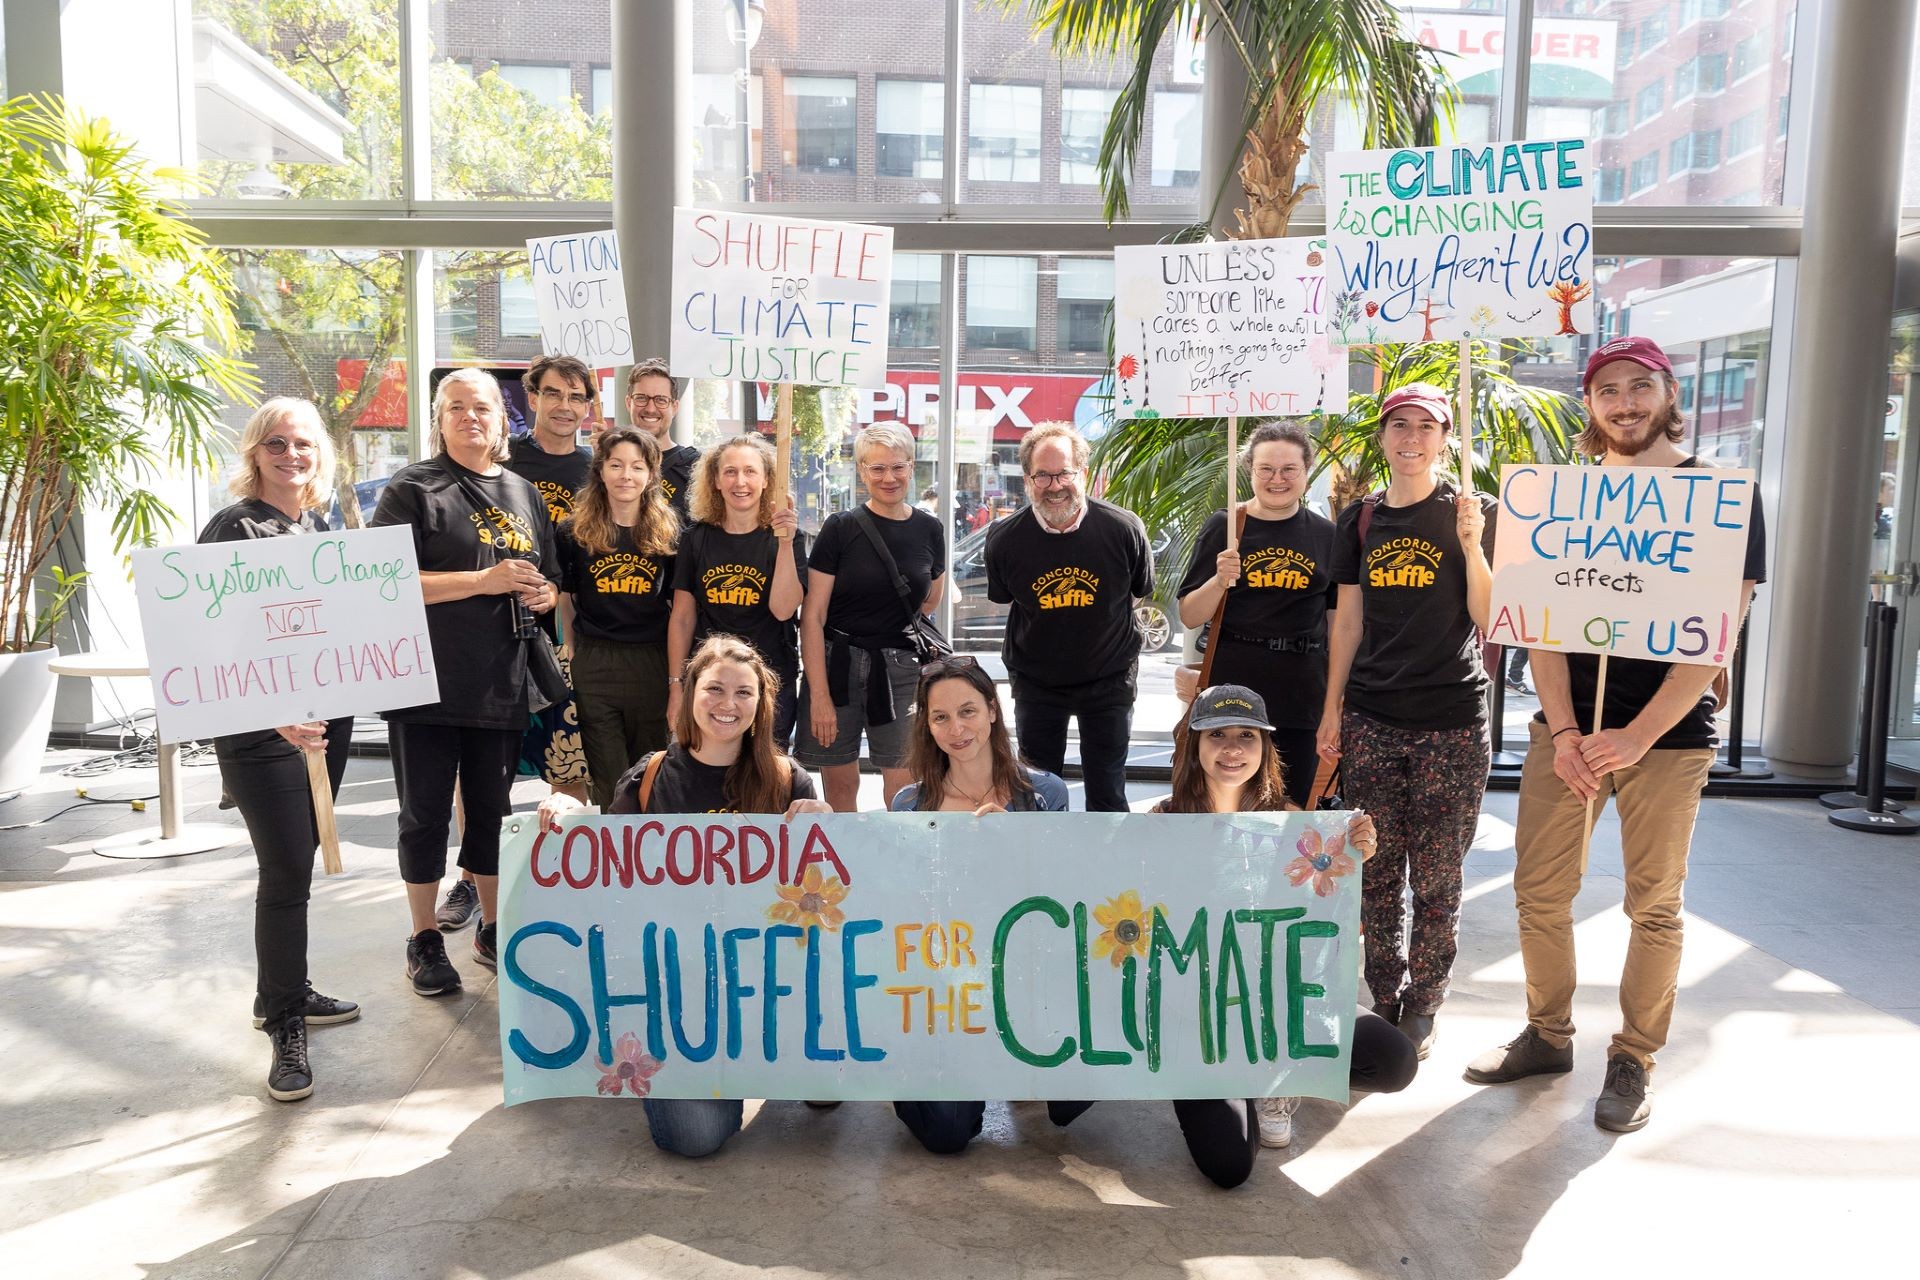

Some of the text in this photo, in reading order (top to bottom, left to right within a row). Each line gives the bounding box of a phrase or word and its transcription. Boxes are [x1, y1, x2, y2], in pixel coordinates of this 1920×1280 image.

[1340, 139, 1585, 201] THE CLIMATE
[1333, 200, 1545, 238] is CHANGING
[532, 234, 619, 276] ACTION
[691, 215, 884, 282] SHUFFLE
[1161, 246, 1276, 285] UNLESS
[770, 276, 809, 301] FOR
[1334, 222, 1590, 323] Why Aren't We?
[553, 278, 612, 311] NOT.
[1166, 289, 1241, 315] someone
[1253, 286, 1287, 314] like
[541, 316, 632, 357] WORDS
[685, 291, 878, 345] CLIMATE
[1206, 318, 1220, 334] a
[1230, 316, 1274, 333] whole
[1278, 316, 1310, 334] awful
[709, 337, 861, 386] JUSTICE
[1155, 338, 1308, 373] nothing is going to get
[1190, 363, 1252, 392] better.
[1177, 392, 1300, 417] IT'S NOT.
[1503, 468, 1748, 529] CLIMATE
[589, 553, 659, 576] CONCORDIA
[1242, 547, 1317, 570] CONCORDIA
[1366, 537, 1444, 564] CONCORDIA
[1531, 519, 1696, 574] CHANGE
[156, 541, 414, 619] System Change
[702, 564, 768, 585] CONCORDIA
[1032, 566, 1101, 592] CONCORDIA
[1554, 567, 1645, 593] affects
[265, 604, 324, 634] NOT
[1489, 604, 1729, 663] ALL OF US!
[162, 633, 431, 707] CLIMATE CHANGE
[530, 820, 852, 890] CONCORDIA
[893, 919, 977, 973] FOR
[503, 919, 888, 1070] SHUFFLE
[884, 982, 988, 1036] THE
